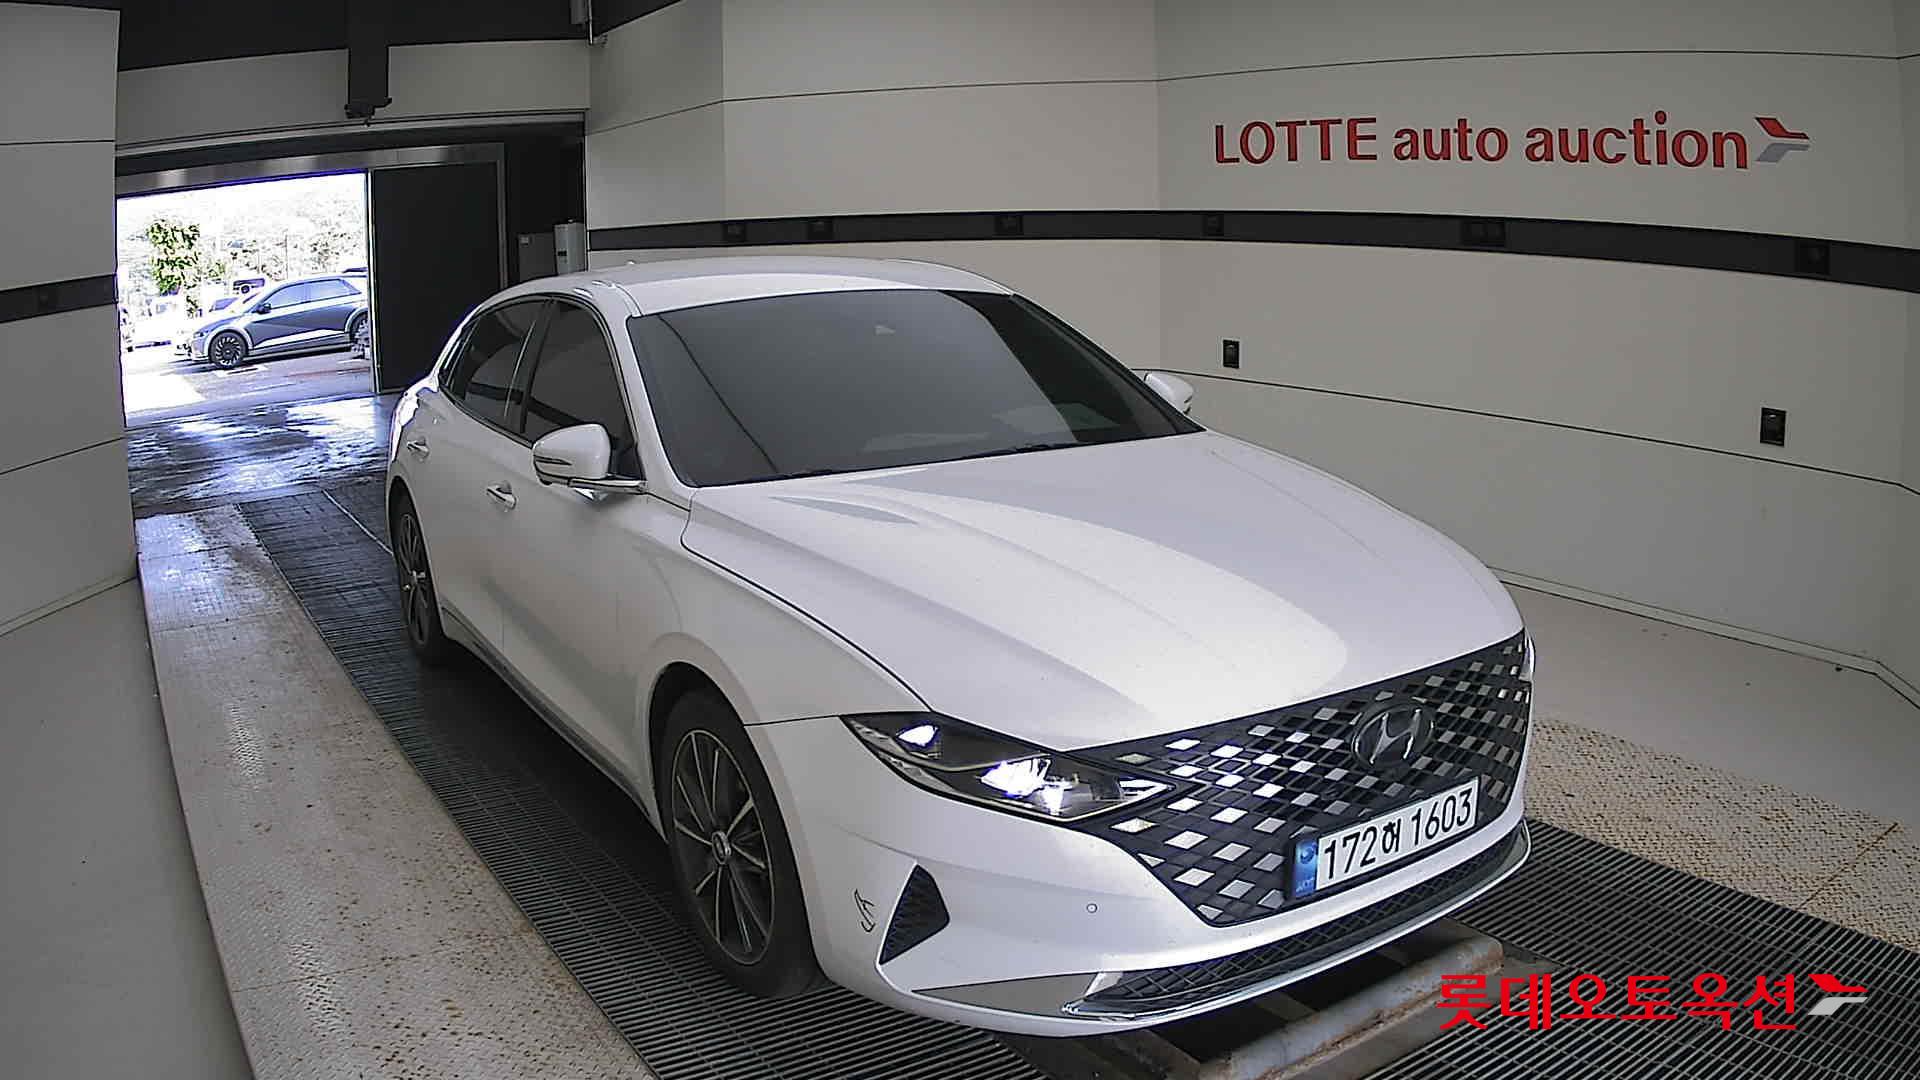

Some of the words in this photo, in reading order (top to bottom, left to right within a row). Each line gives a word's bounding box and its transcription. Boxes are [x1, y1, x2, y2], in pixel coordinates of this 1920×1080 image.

[1214, 117, 1378, 162] LOTTE
[1393, 119, 1509, 163] auto
[1525, 111, 1749, 169] auction
[1323, 818, 1403, 880] 172허
[1410, 787, 1474, 846] 1603
